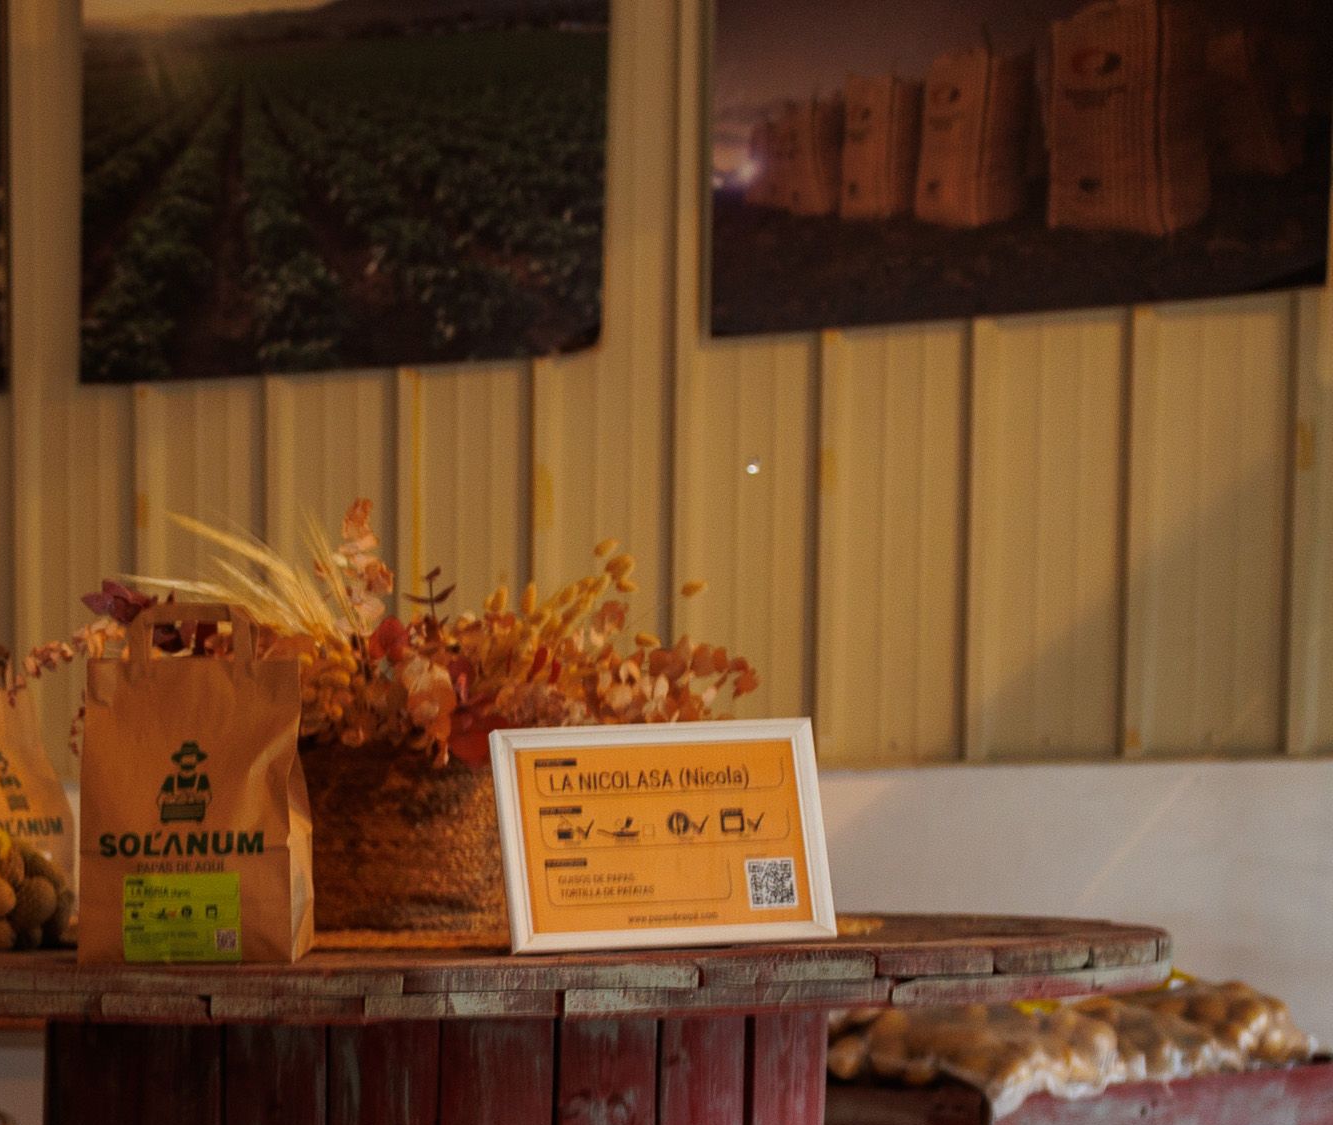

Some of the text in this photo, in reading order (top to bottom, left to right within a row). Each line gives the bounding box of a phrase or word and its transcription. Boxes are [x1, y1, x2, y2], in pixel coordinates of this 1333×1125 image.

[550, 763, 750, 793] LA NICOLASA (Nicola)
